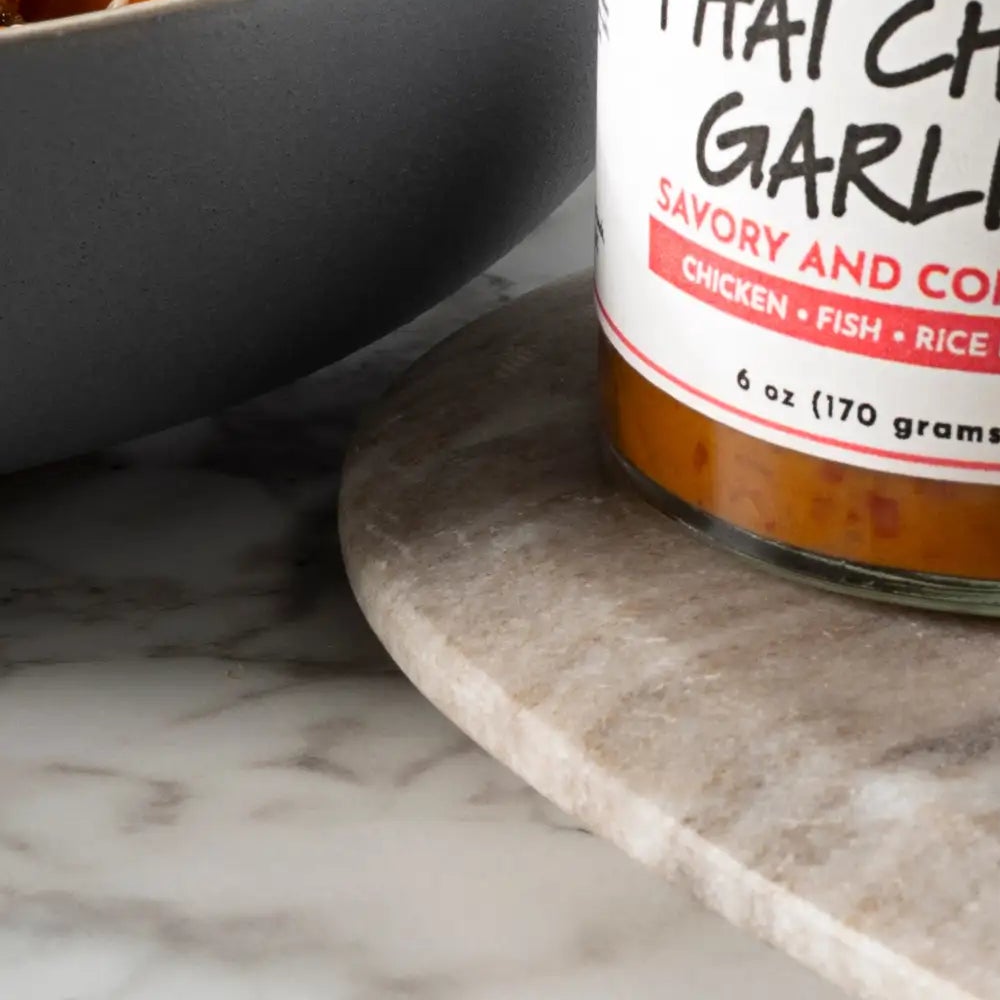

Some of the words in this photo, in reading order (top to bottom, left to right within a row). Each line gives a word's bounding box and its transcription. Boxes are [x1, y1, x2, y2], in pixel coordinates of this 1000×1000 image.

[657, 177, 790, 263] SAVORY
[800, 241, 901, 291] AND
[682, 254, 787, 320] CHICKEN
[816, 306, 882, 343] FISH
[915, 324, 988, 357] RICE
[736, 368, 750, 391] 6
[764, 383, 796, 408] oz
[812, 390, 877, 427] (170
